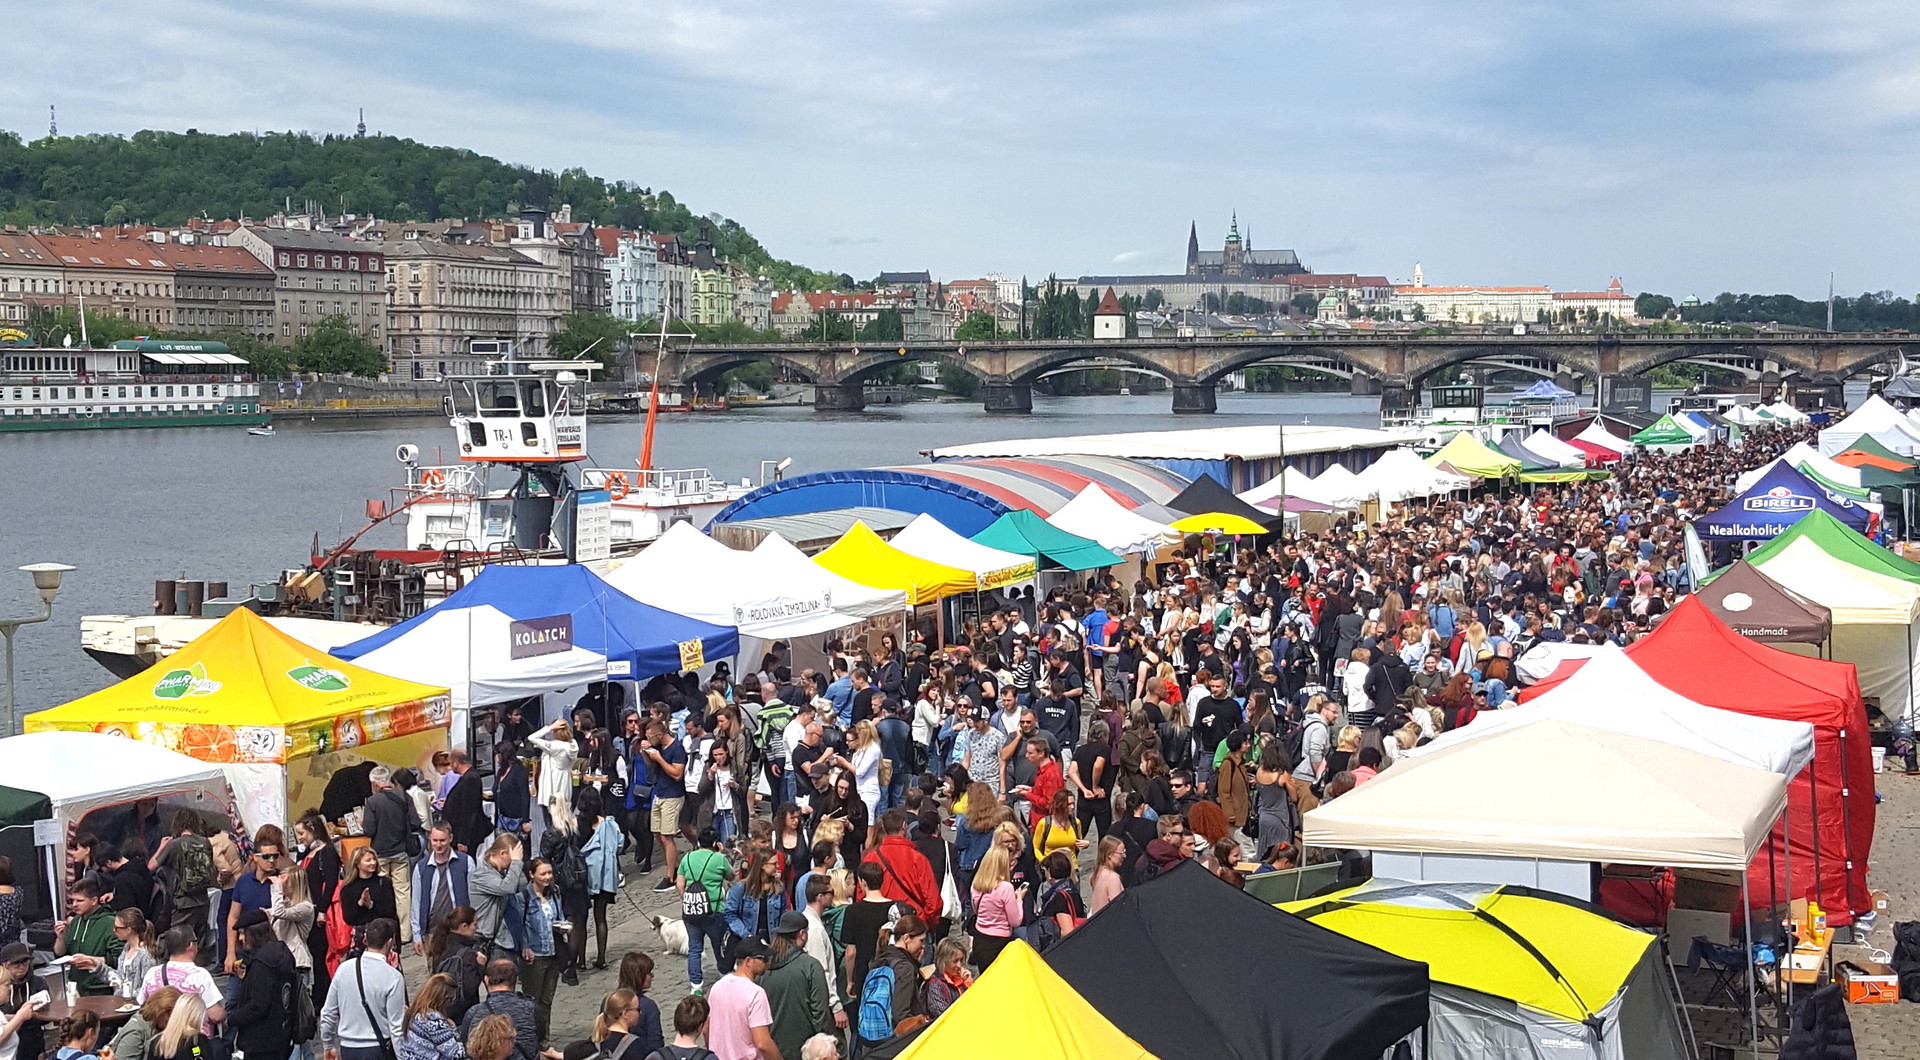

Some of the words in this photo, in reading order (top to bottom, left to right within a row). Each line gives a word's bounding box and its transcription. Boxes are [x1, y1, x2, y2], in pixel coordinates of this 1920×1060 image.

[493, 429, 514, 441] TR-1
[1751, 499, 1810, 509] BIRELL
[515, 626, 567, 647] KOLATCH
[1741, 627, 1789, 636] Handmade
